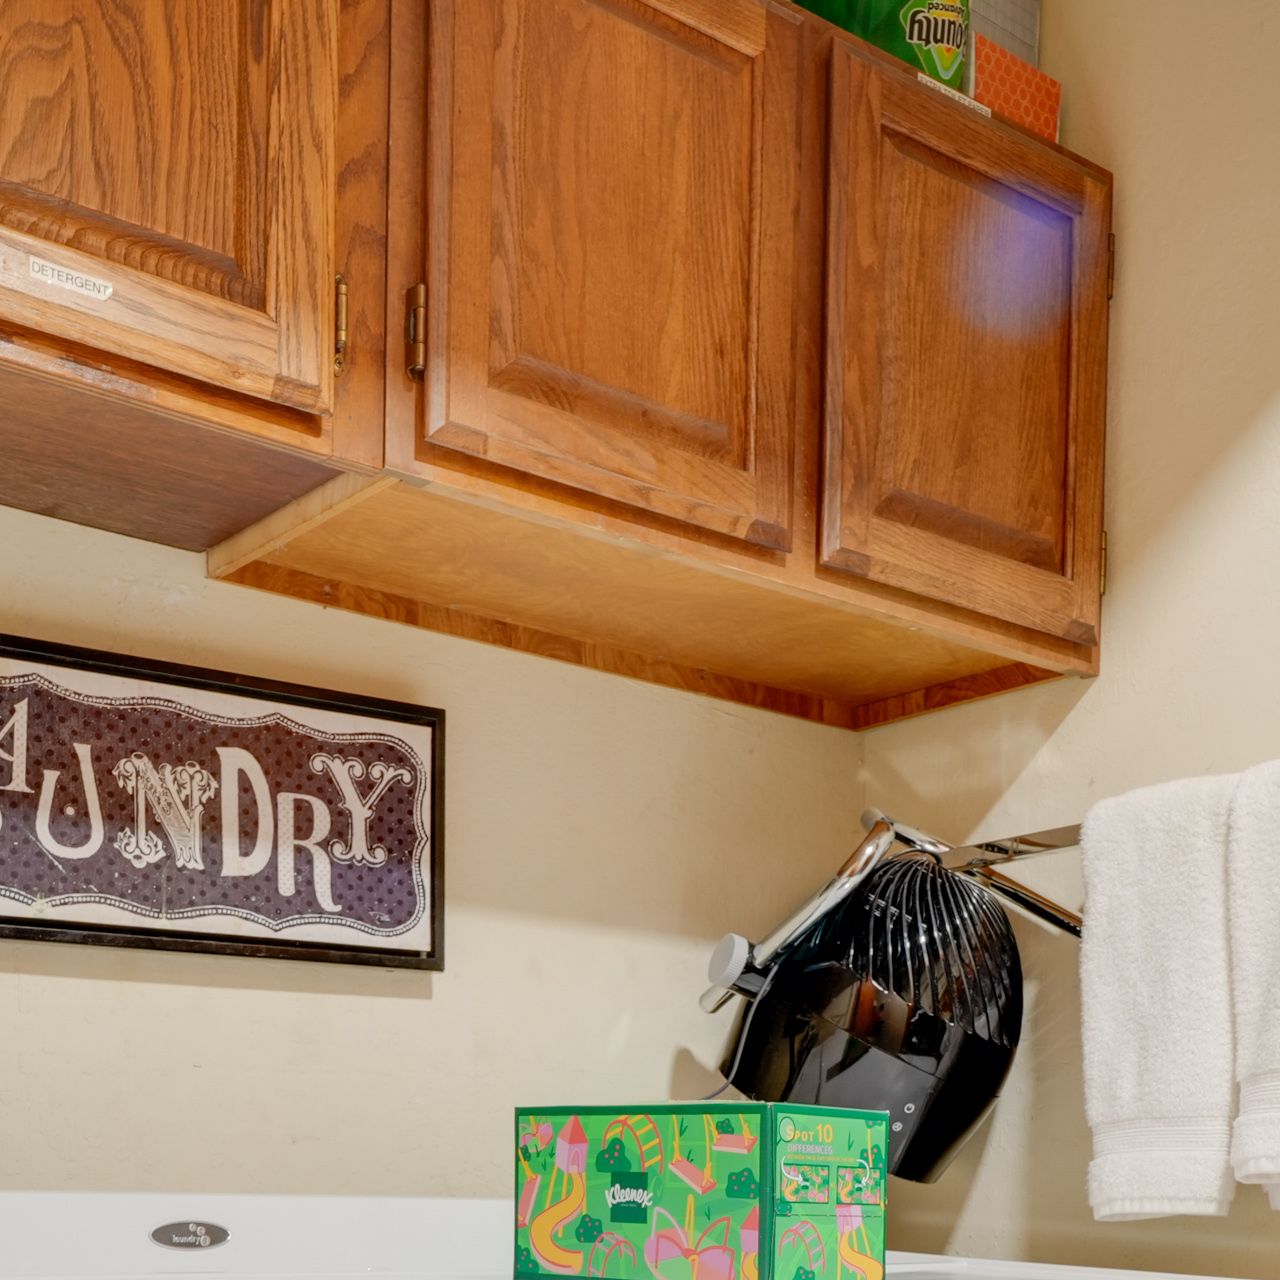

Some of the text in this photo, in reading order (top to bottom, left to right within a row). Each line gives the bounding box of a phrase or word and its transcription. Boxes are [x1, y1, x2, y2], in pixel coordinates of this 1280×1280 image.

[908, 9, 968, 51] ounty
[31, 260, 110, 297] DETERGENT
[817, 1123, 833, 1144] 10
[788, 1144, 833, 1155] DIFFERENCES
[604, 1183, 654, 1209] Kleenex
